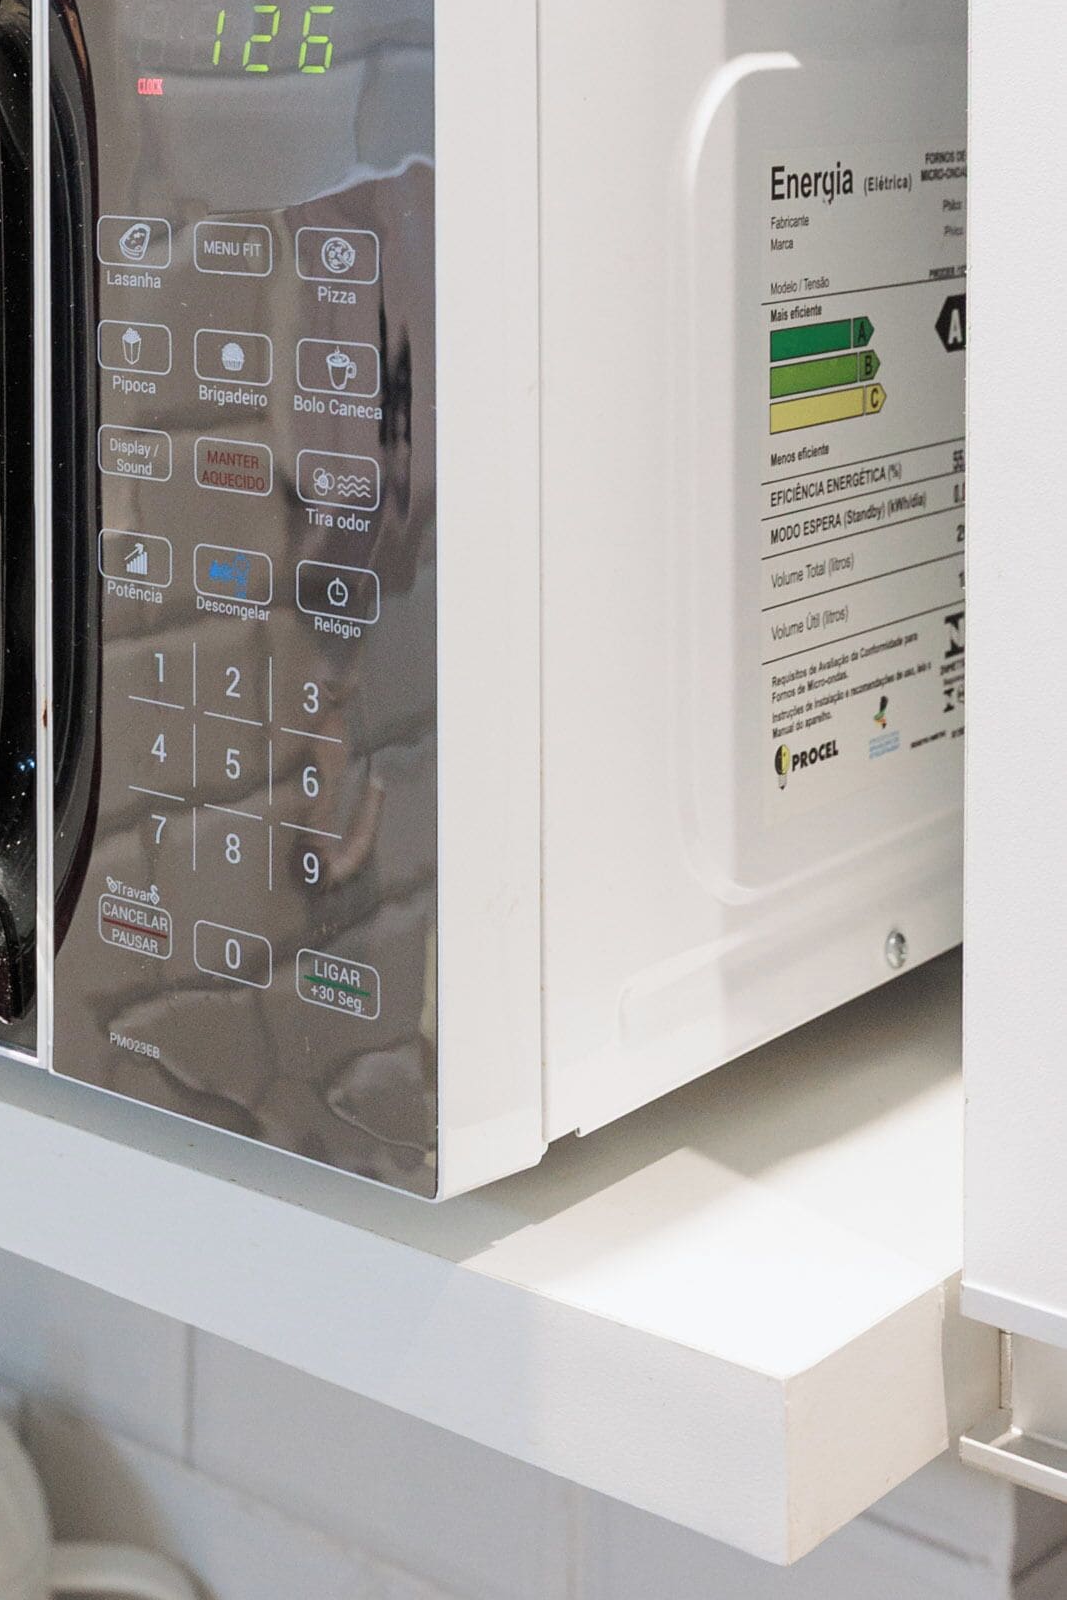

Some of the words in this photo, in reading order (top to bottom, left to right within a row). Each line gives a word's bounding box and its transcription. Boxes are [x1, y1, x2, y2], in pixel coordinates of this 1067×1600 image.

[770, 161, 855, 206] Energia
[863, 172, 913, 197] (Elétrica)
[770, 215, 810, 230] Fabricante
[203, 240, 241, 257] MENU
[242, 242, 263, 258] FIT
[770, 238, 794, 252] Marca
[106, 270, 163, 290] Lasanha
[770, 279, 798, 296] Modelo
[803, 276, 830, 291] Tensão
[317, 285, 358, 306] Pizza
[770, 307, 788, 323] Mais
[790, 304, 823, 320] eficiente
[947, 308, 964, 345] A
[857, 320, 867, 344] A
[864, 354, 874, 376] B
[112, 375, 157, 396] Pipoca
[198, 384, 269, 409] Brigadeiro
[870, 387, 879, 409] C
[293, 394, 327, 416] Bolo
[328, 398, 384, 422] Caneca
[109, 437, 151, 458] Display
[206, 450, 260, 470] MANTER
[770, 451, 796, 467] Menos
[797, 443, 830, 461] eficiente
[116, 457, 153, 477] Sound
[201, 469, 266, 492] AQUECIDO
[770, 482, 825, 508] EFICIÊNCIA
[828, 465, 885, 493] ENERGÉTICA
[305, 507, 335, 528] Tira
[336, 511, 371, 533] odor
[770, 522, 802, 545] MODO
[803, 513, 842, 537] ESPERA
[844, 502, 885, 528] (Standby)
[771, 569, 805, 589] Volume
[805, 560, 827, 579] Total
[106, 580, 164, 605] Potência
[195, 595, 272, 623] Descongelar
[313, 615, 363, 640] Relógio
[771, 621, 805, 641] Volume
[806, 611, 821, 631] Útil
[154, 652, 165, 684] 1
[224, 666, 242, 699] 2
[301, 681, 321, 715] 3
[149, 733, 168, 763] 4
[791, 739, 840, 773] PROCEL
[224, 747, 242, 780] 5
[301, 765, 321, 799] 6
[150, 814, 168, 845] 7
[224, 832, 243, 865] 8
[301, 852, 321, 885] 9
[102, 900, 169, 932] CANCELAR
[111, 927, 160, 955] PAUSAR
[224, 938, 243, 970] 0
[314, 959, 361, 987] LIGAR
[309, 984, 335, 1003] +30
[337, 990, 366, 1014] Seg.
